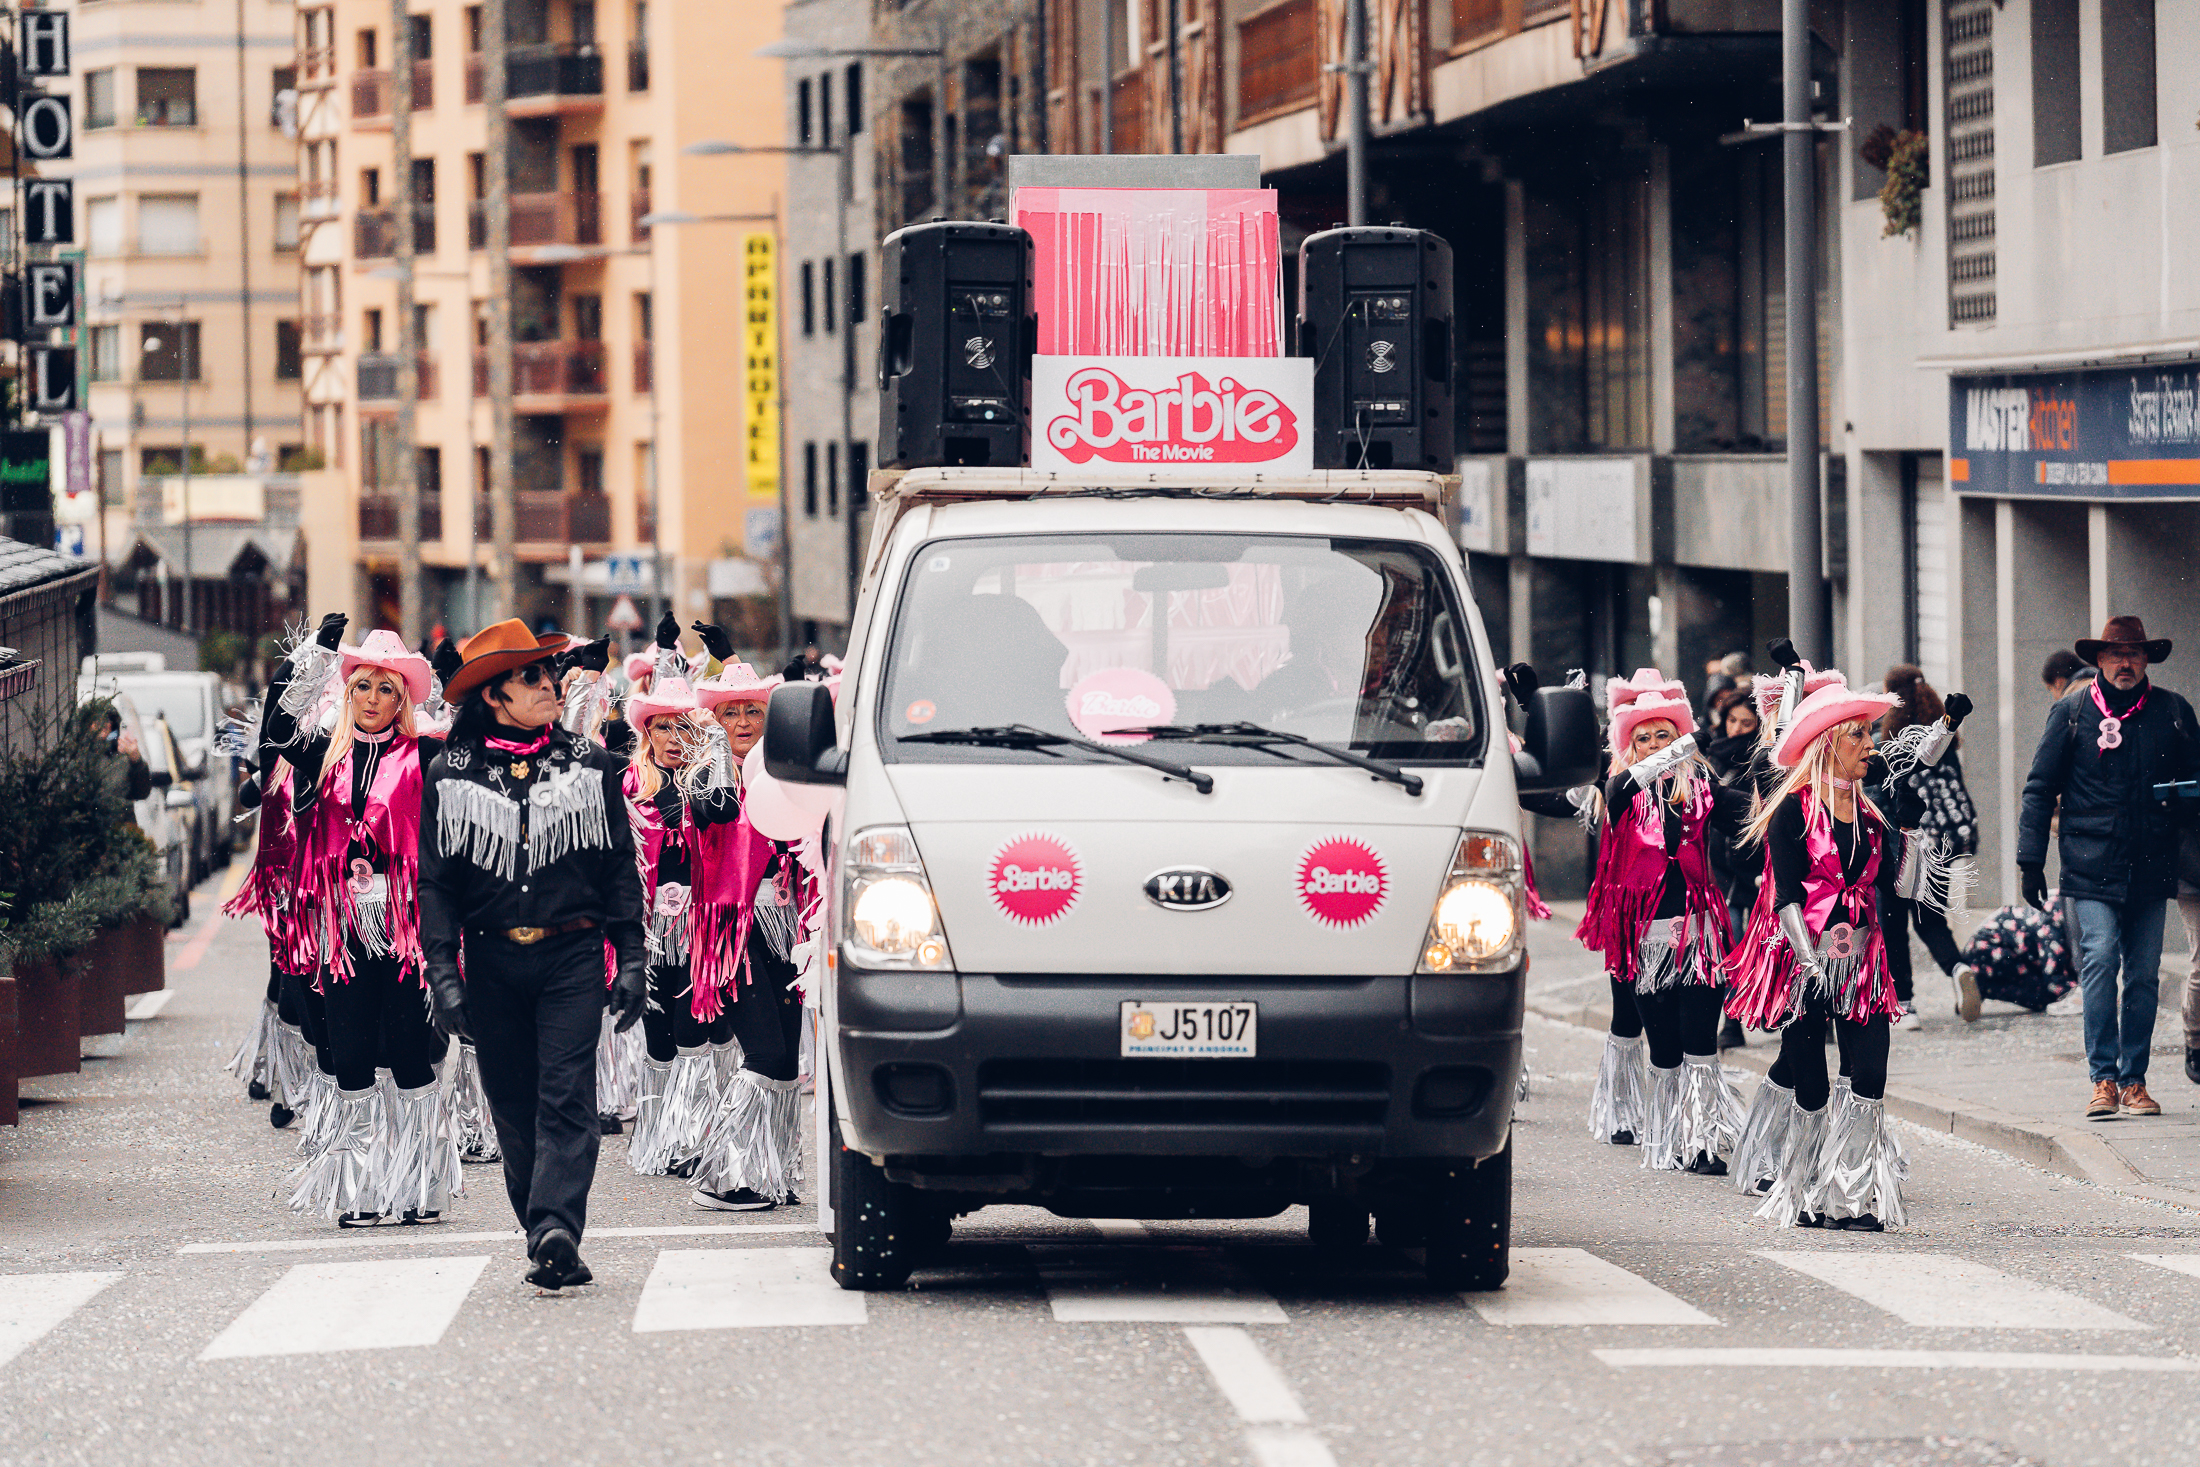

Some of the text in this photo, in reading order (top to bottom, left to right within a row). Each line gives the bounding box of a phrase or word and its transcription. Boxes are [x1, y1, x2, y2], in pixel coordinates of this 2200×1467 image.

[24, 15, 71, 408] HOTEL
[1049, 367, 1284, 449] Barbie
[1130, 444, 1214, 461] The Movie
[1080, 691, 1161, 718] Barbie
[997, 863, 1075, 893] Barbie
[1157, 874, 1219, 900] KIA
[1304, 866, 1380, 895] Barbie
[1160, 1008, 1250, 1041] J5107
